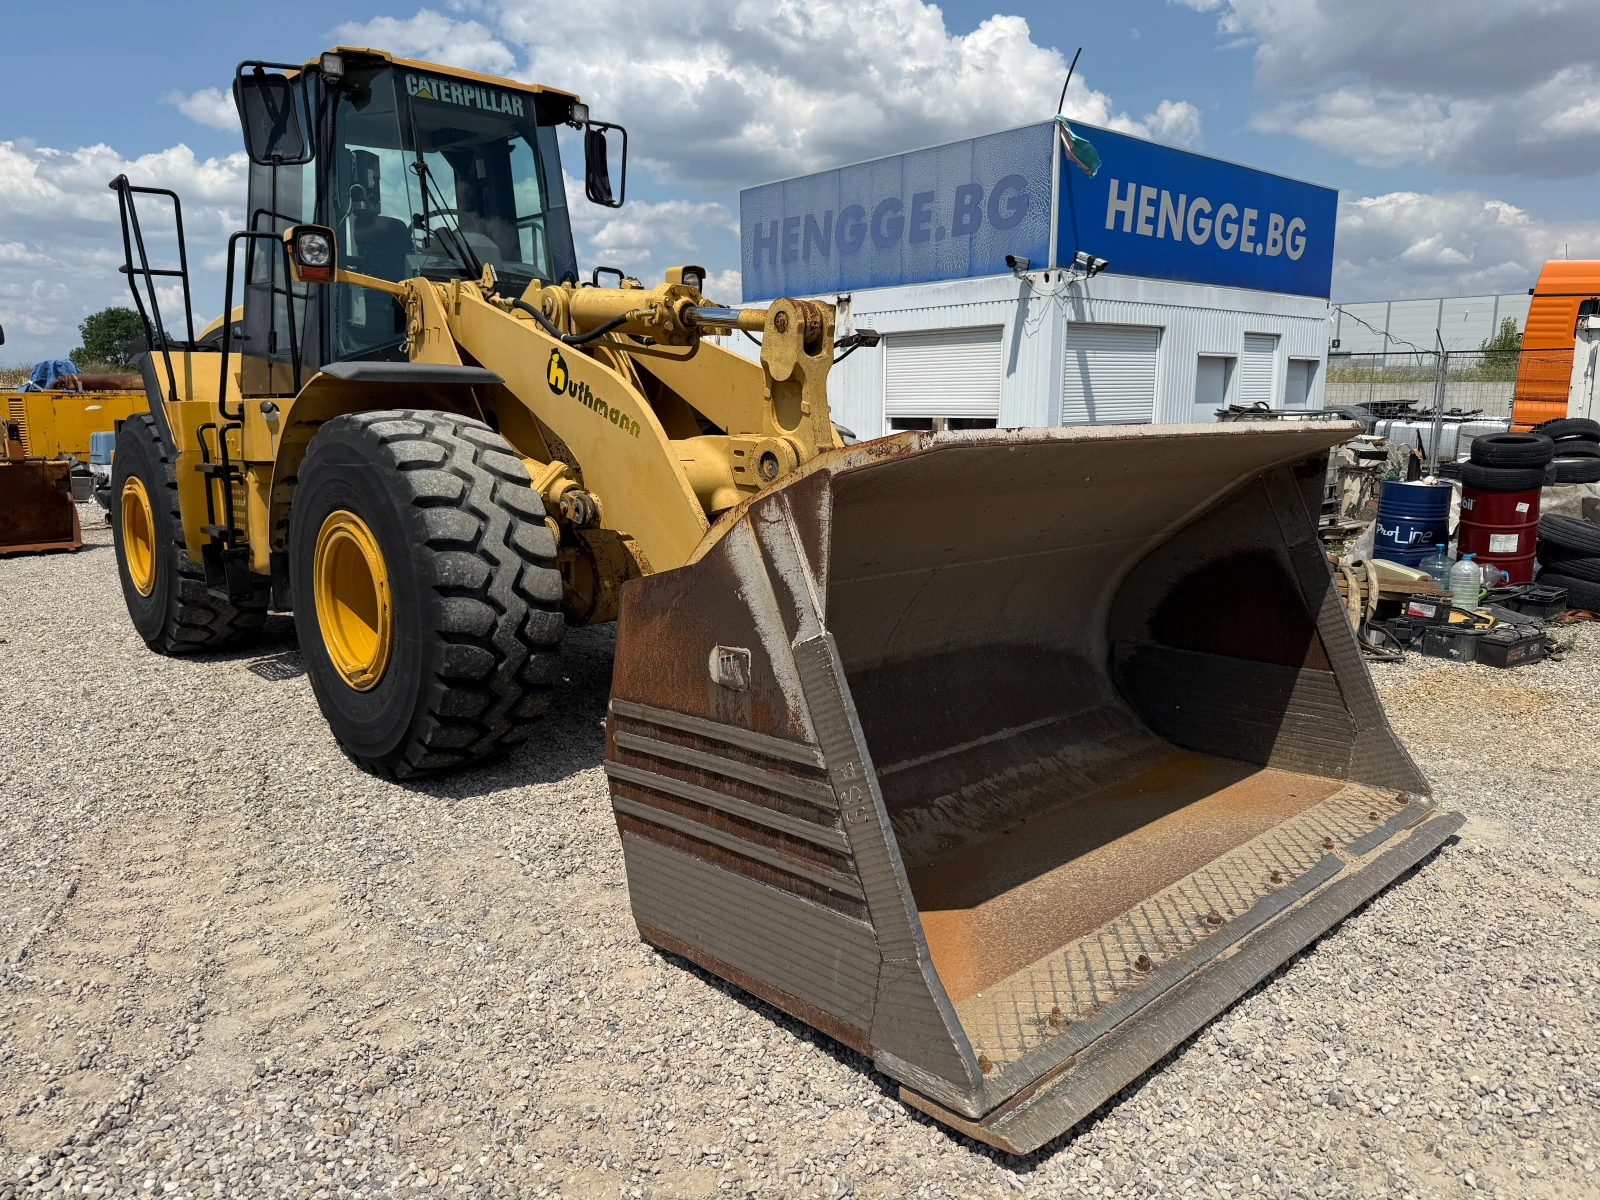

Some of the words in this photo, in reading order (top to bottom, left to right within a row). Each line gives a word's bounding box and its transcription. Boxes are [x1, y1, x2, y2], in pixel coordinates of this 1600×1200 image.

[405, 74, 524, 117] CATERPILLAR
[753, 174, 1029, 267] HENGGE.BG
[1105, 178, 1307, 261] HENGGE.BG
